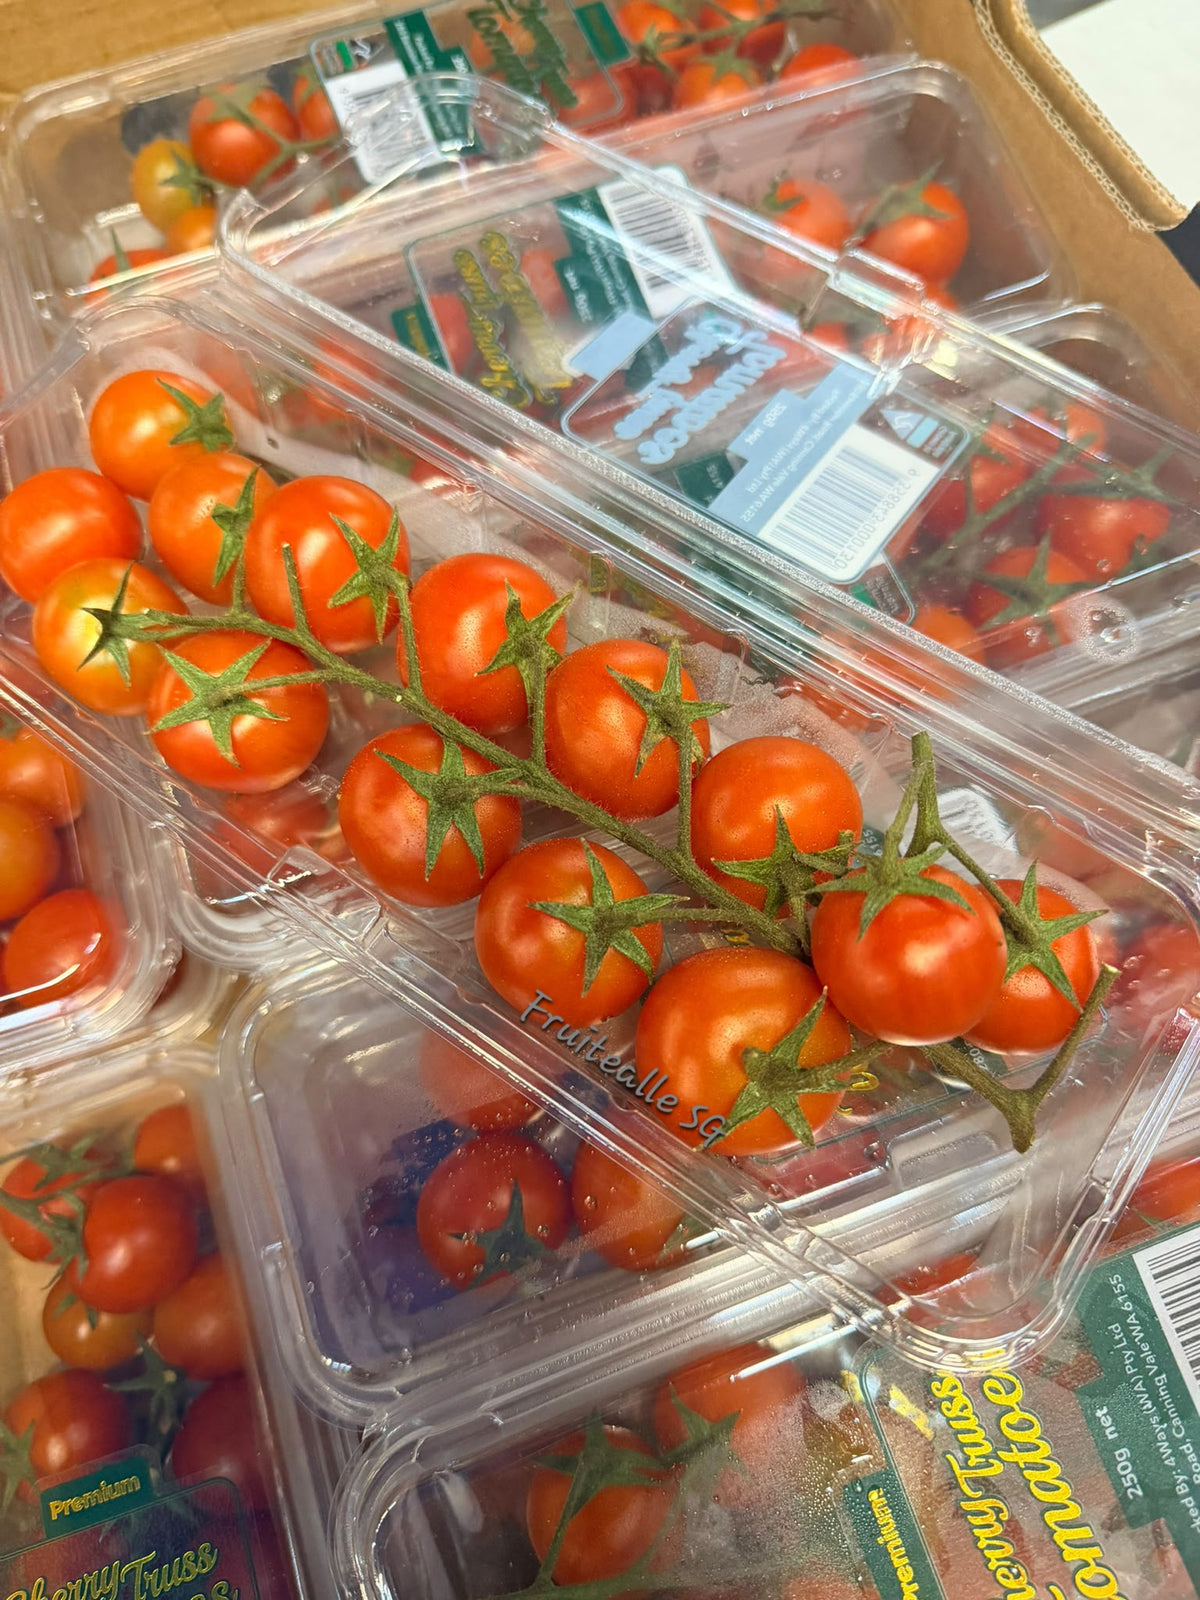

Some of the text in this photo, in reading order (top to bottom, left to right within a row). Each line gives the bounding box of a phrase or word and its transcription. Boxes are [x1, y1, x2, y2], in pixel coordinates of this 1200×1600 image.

[1107, 1272, 1134, 1313] 6155
[1124, 1311, 1146, 1342] WA
[1136, 1340, 1161, 1376] Vale
[930, 1369, 1005, 1498] Truss
[1104, 1321, 1200, 1534] ked By: 4Ways (WA) Pty Ltd
[1150, 1372, 1190, 1439] Canning
[980, 1366, 1120, 1600] omatoe
[1092, 1403, 1147, 1501] 250g net
[49, 1473, 141, 1521] Premium
[120, 1542, 219, 1600] Truss
